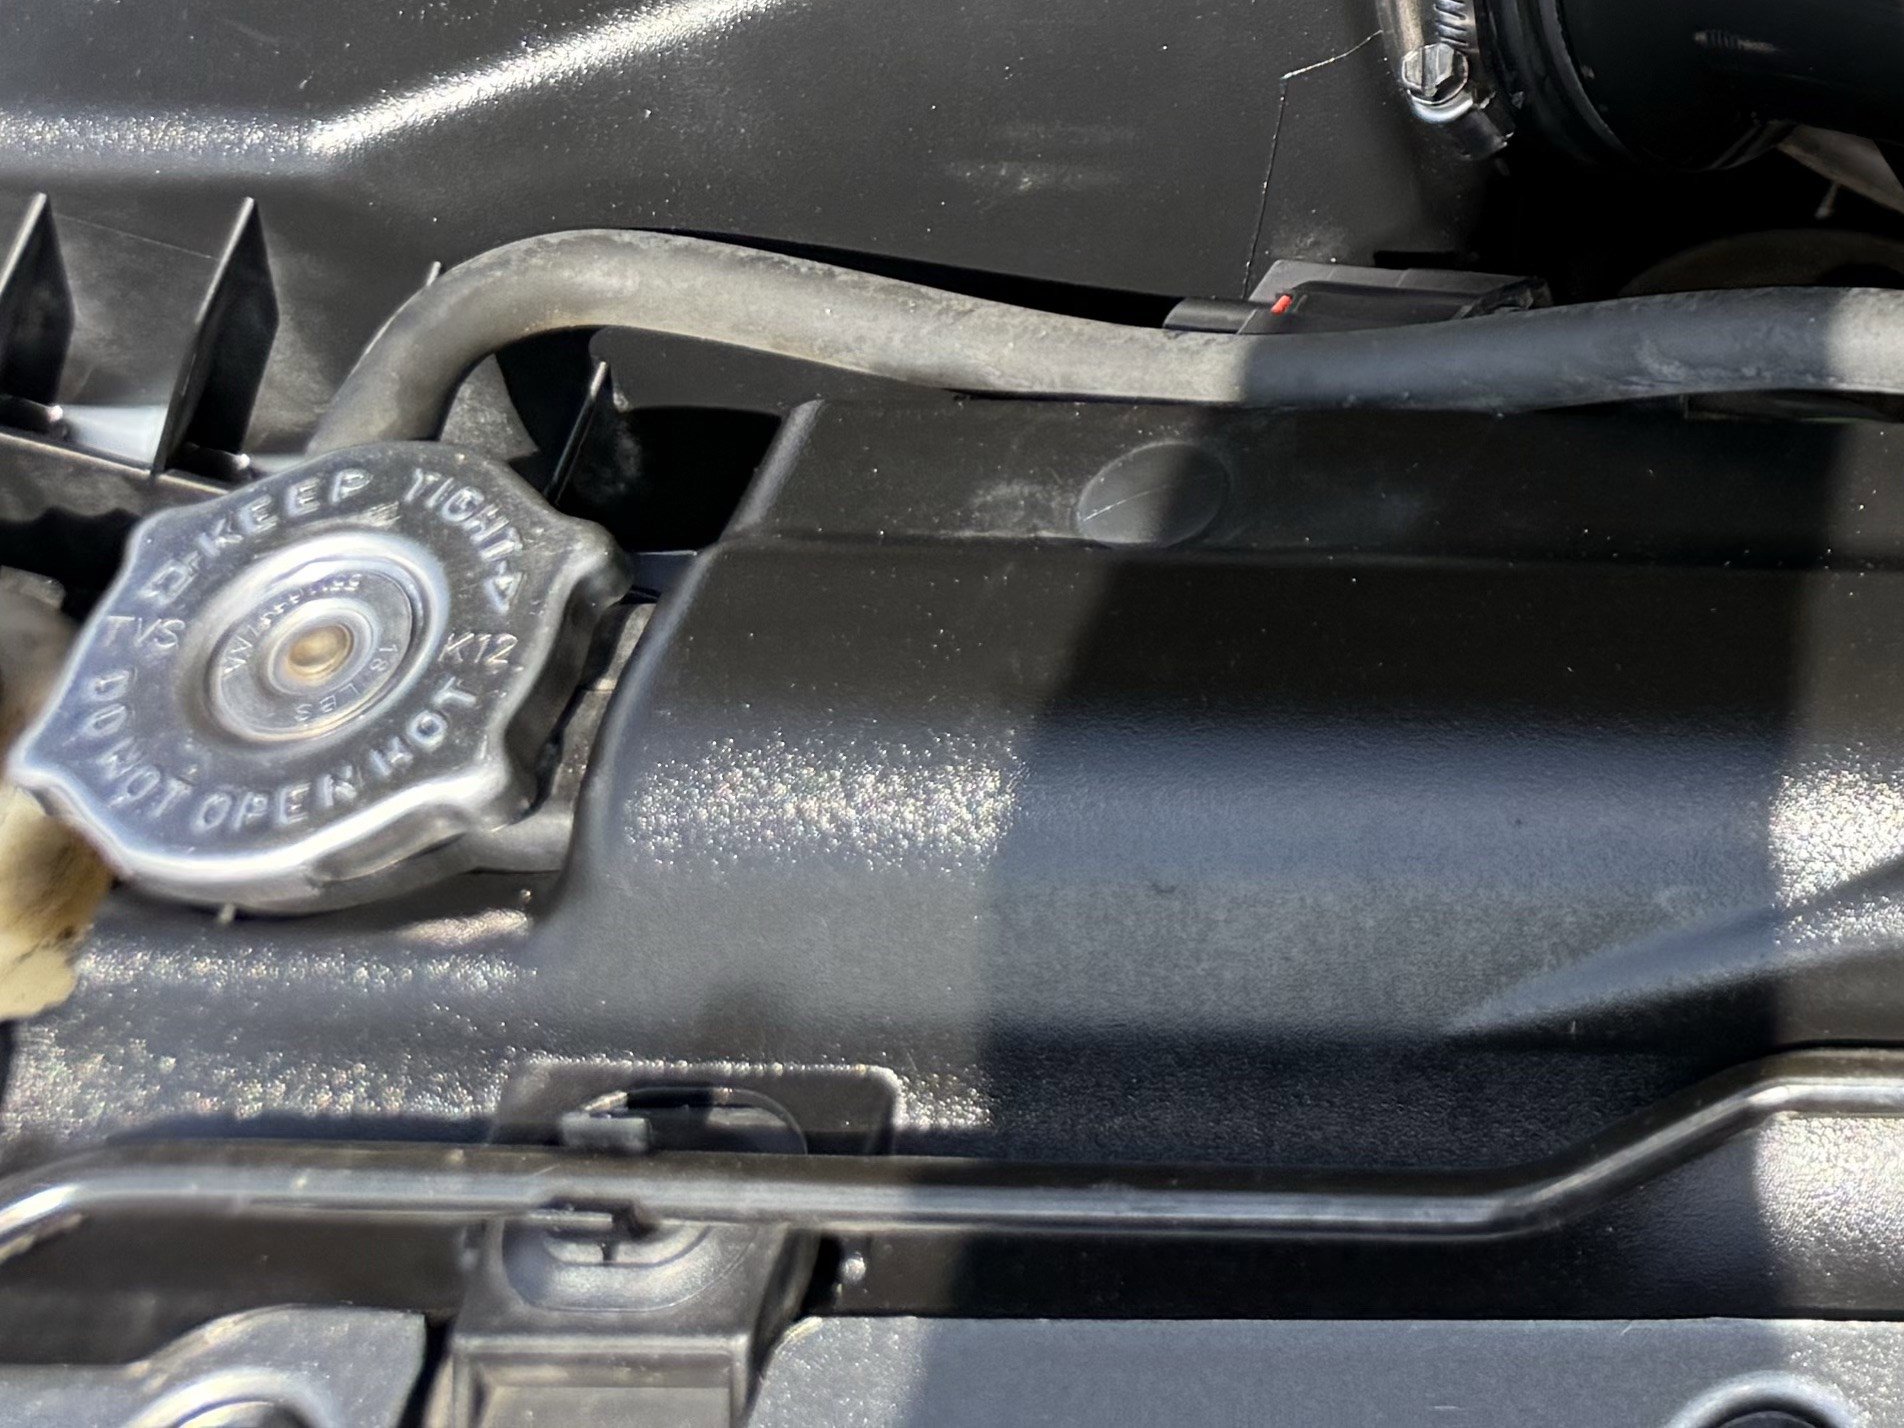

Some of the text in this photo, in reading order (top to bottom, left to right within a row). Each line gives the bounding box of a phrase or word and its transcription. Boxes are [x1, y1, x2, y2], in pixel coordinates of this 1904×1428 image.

[196, 467, 524, 563] KEEP TIGHT
[104, 614, 187, 649] TVS
[437, 629, 520, 666] K12
[85, 667, 478, 833] DO NOT OPEN HOT
